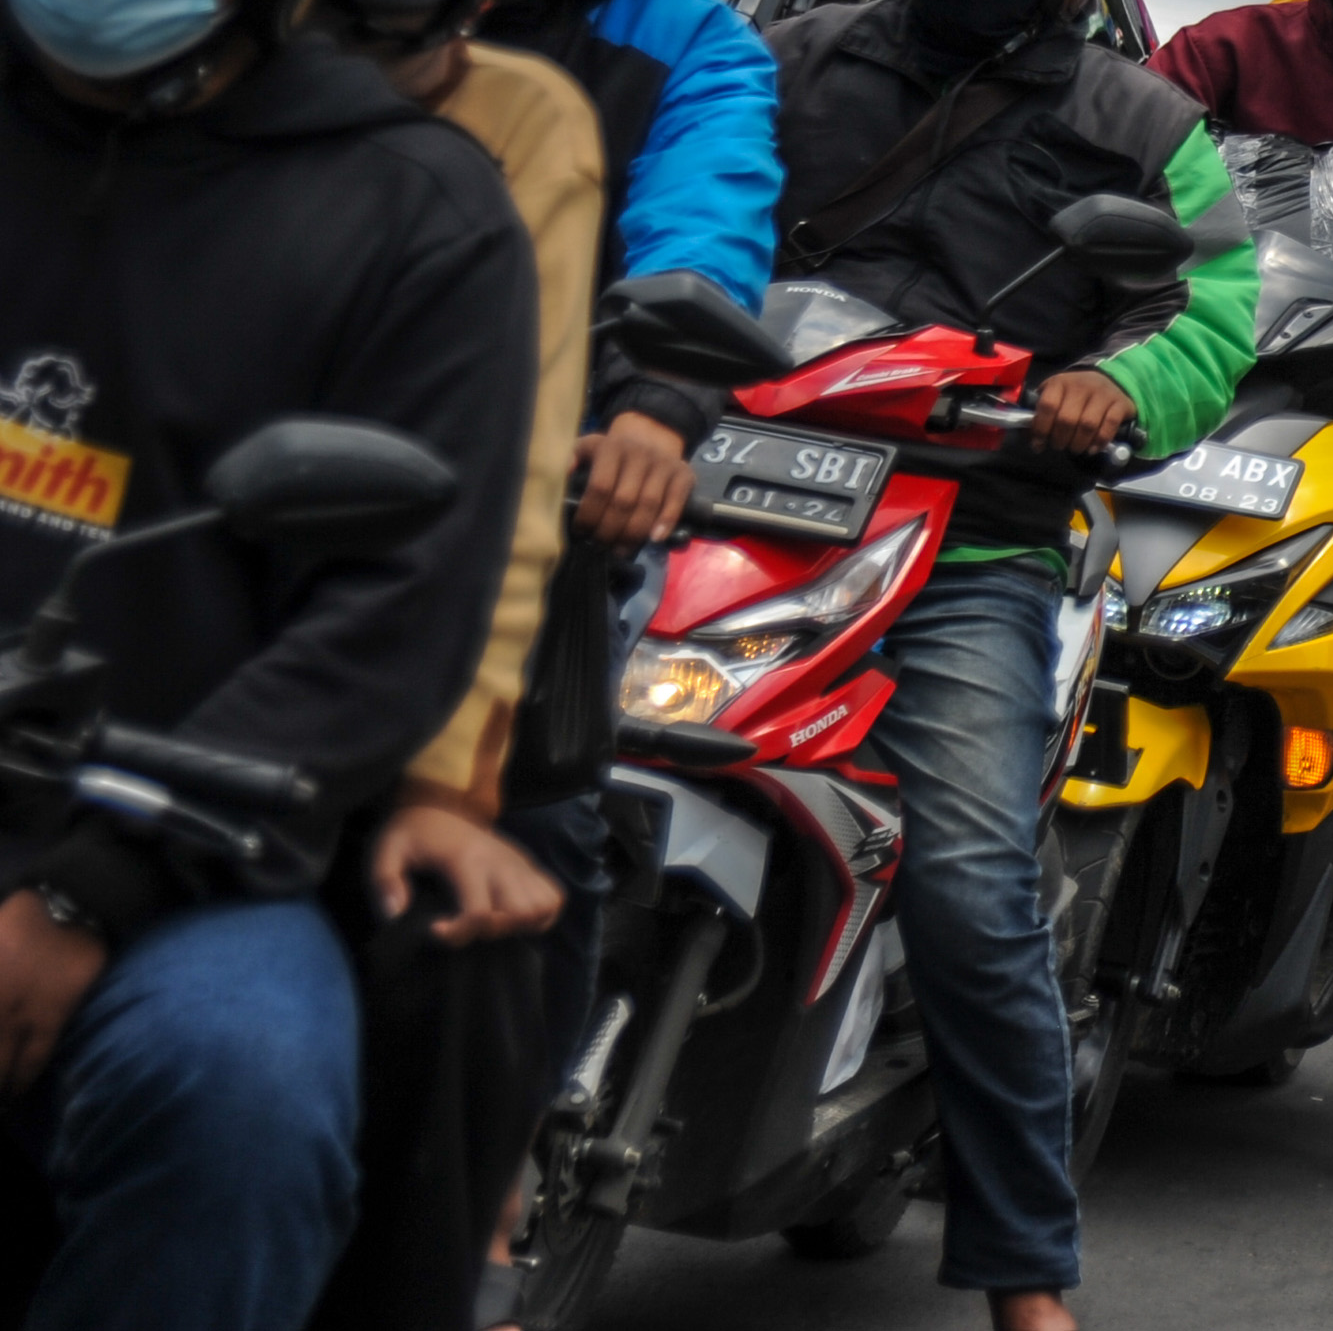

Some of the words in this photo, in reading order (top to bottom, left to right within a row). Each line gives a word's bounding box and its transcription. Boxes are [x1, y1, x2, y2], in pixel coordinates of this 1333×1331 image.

[785, 285, 847, 303] HONDA
[789, 447, 869, 491] SBI
[1219, 454, 1295, 489] ABX
[788, 703, 849, 749] HONDA
